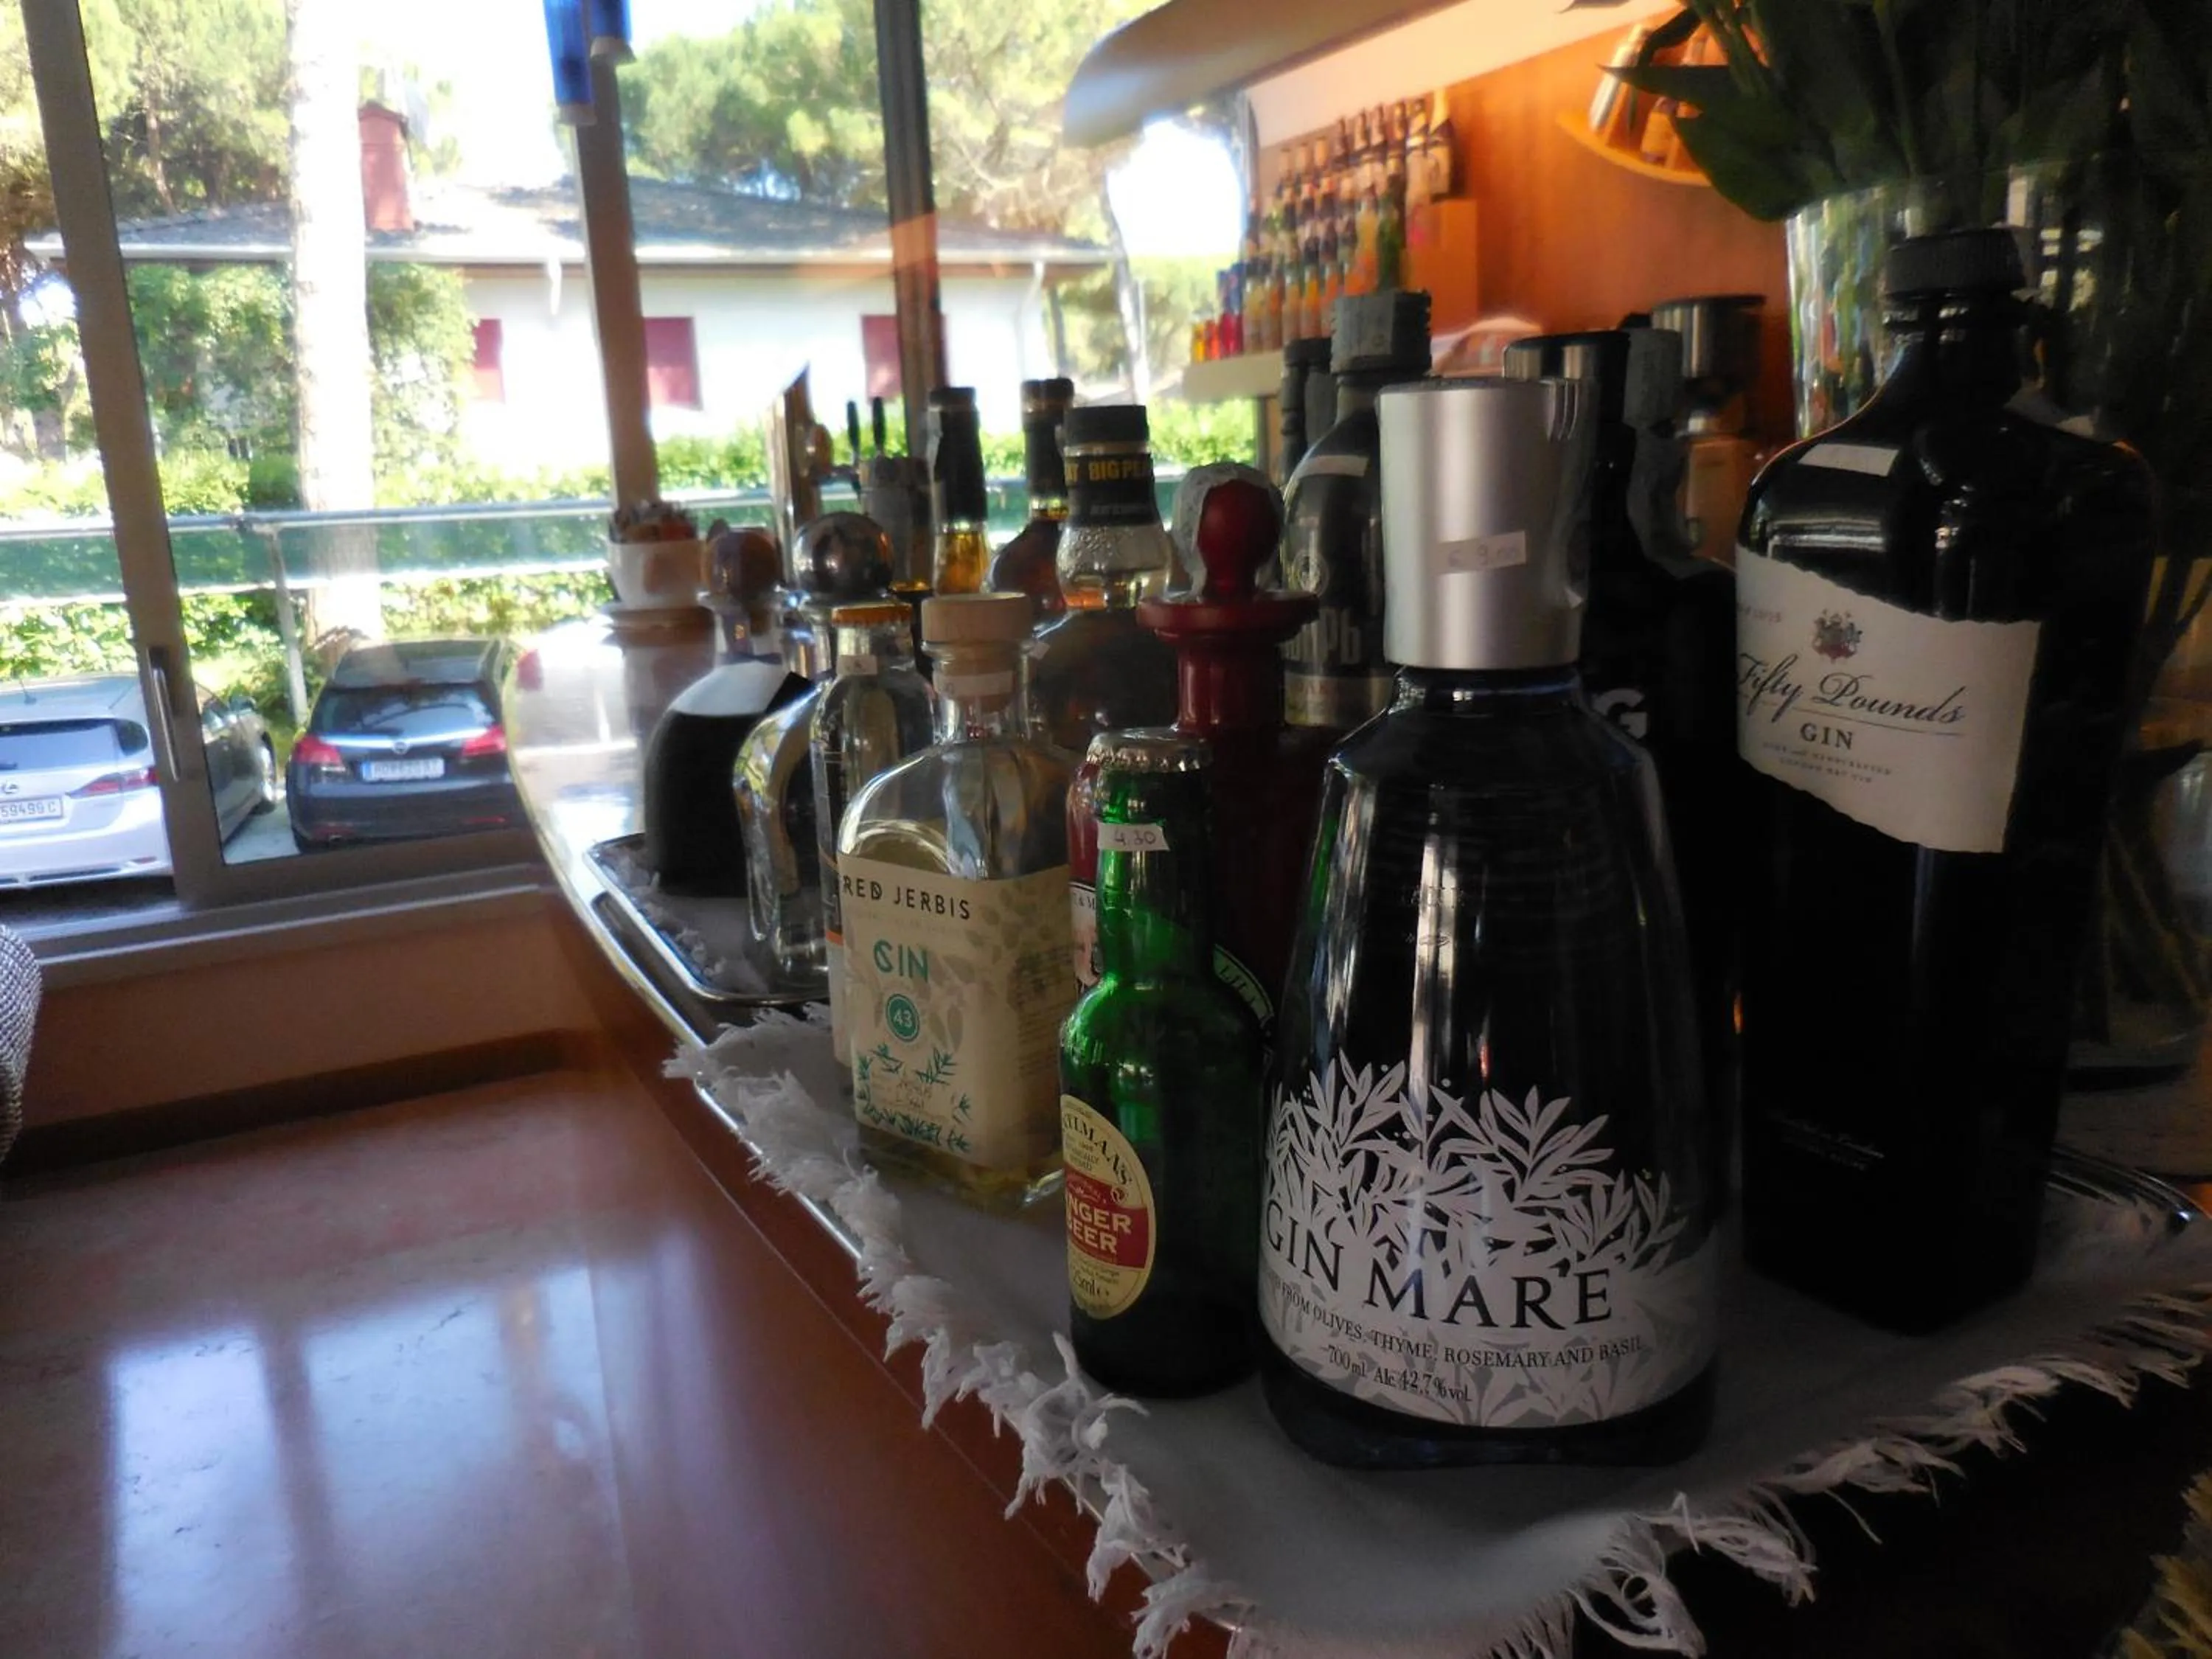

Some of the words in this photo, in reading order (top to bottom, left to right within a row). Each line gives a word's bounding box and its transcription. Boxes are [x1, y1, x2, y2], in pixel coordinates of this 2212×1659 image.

[1738, 652, 1804, 724] Fifty
[1812, 672, 1966, 726] Pounds
[1799, 722, 1854, 751] GIN
[843, 875, 883, 900] RED
[894, 888, 970, 919] JERBIS
[873, 939, 929, 984] GIN
[892, 1008, 913, 1028] 43
[1266, 1198, 1344, 1293] GIN
[1363, 1258, 1613, 1331] MARE
[1444, 1346, 1551, 1368] ROSEMARY
[1554, 1346, 1594, 1366] AND
[1599, 1335, 1645, 1361] BASIL
